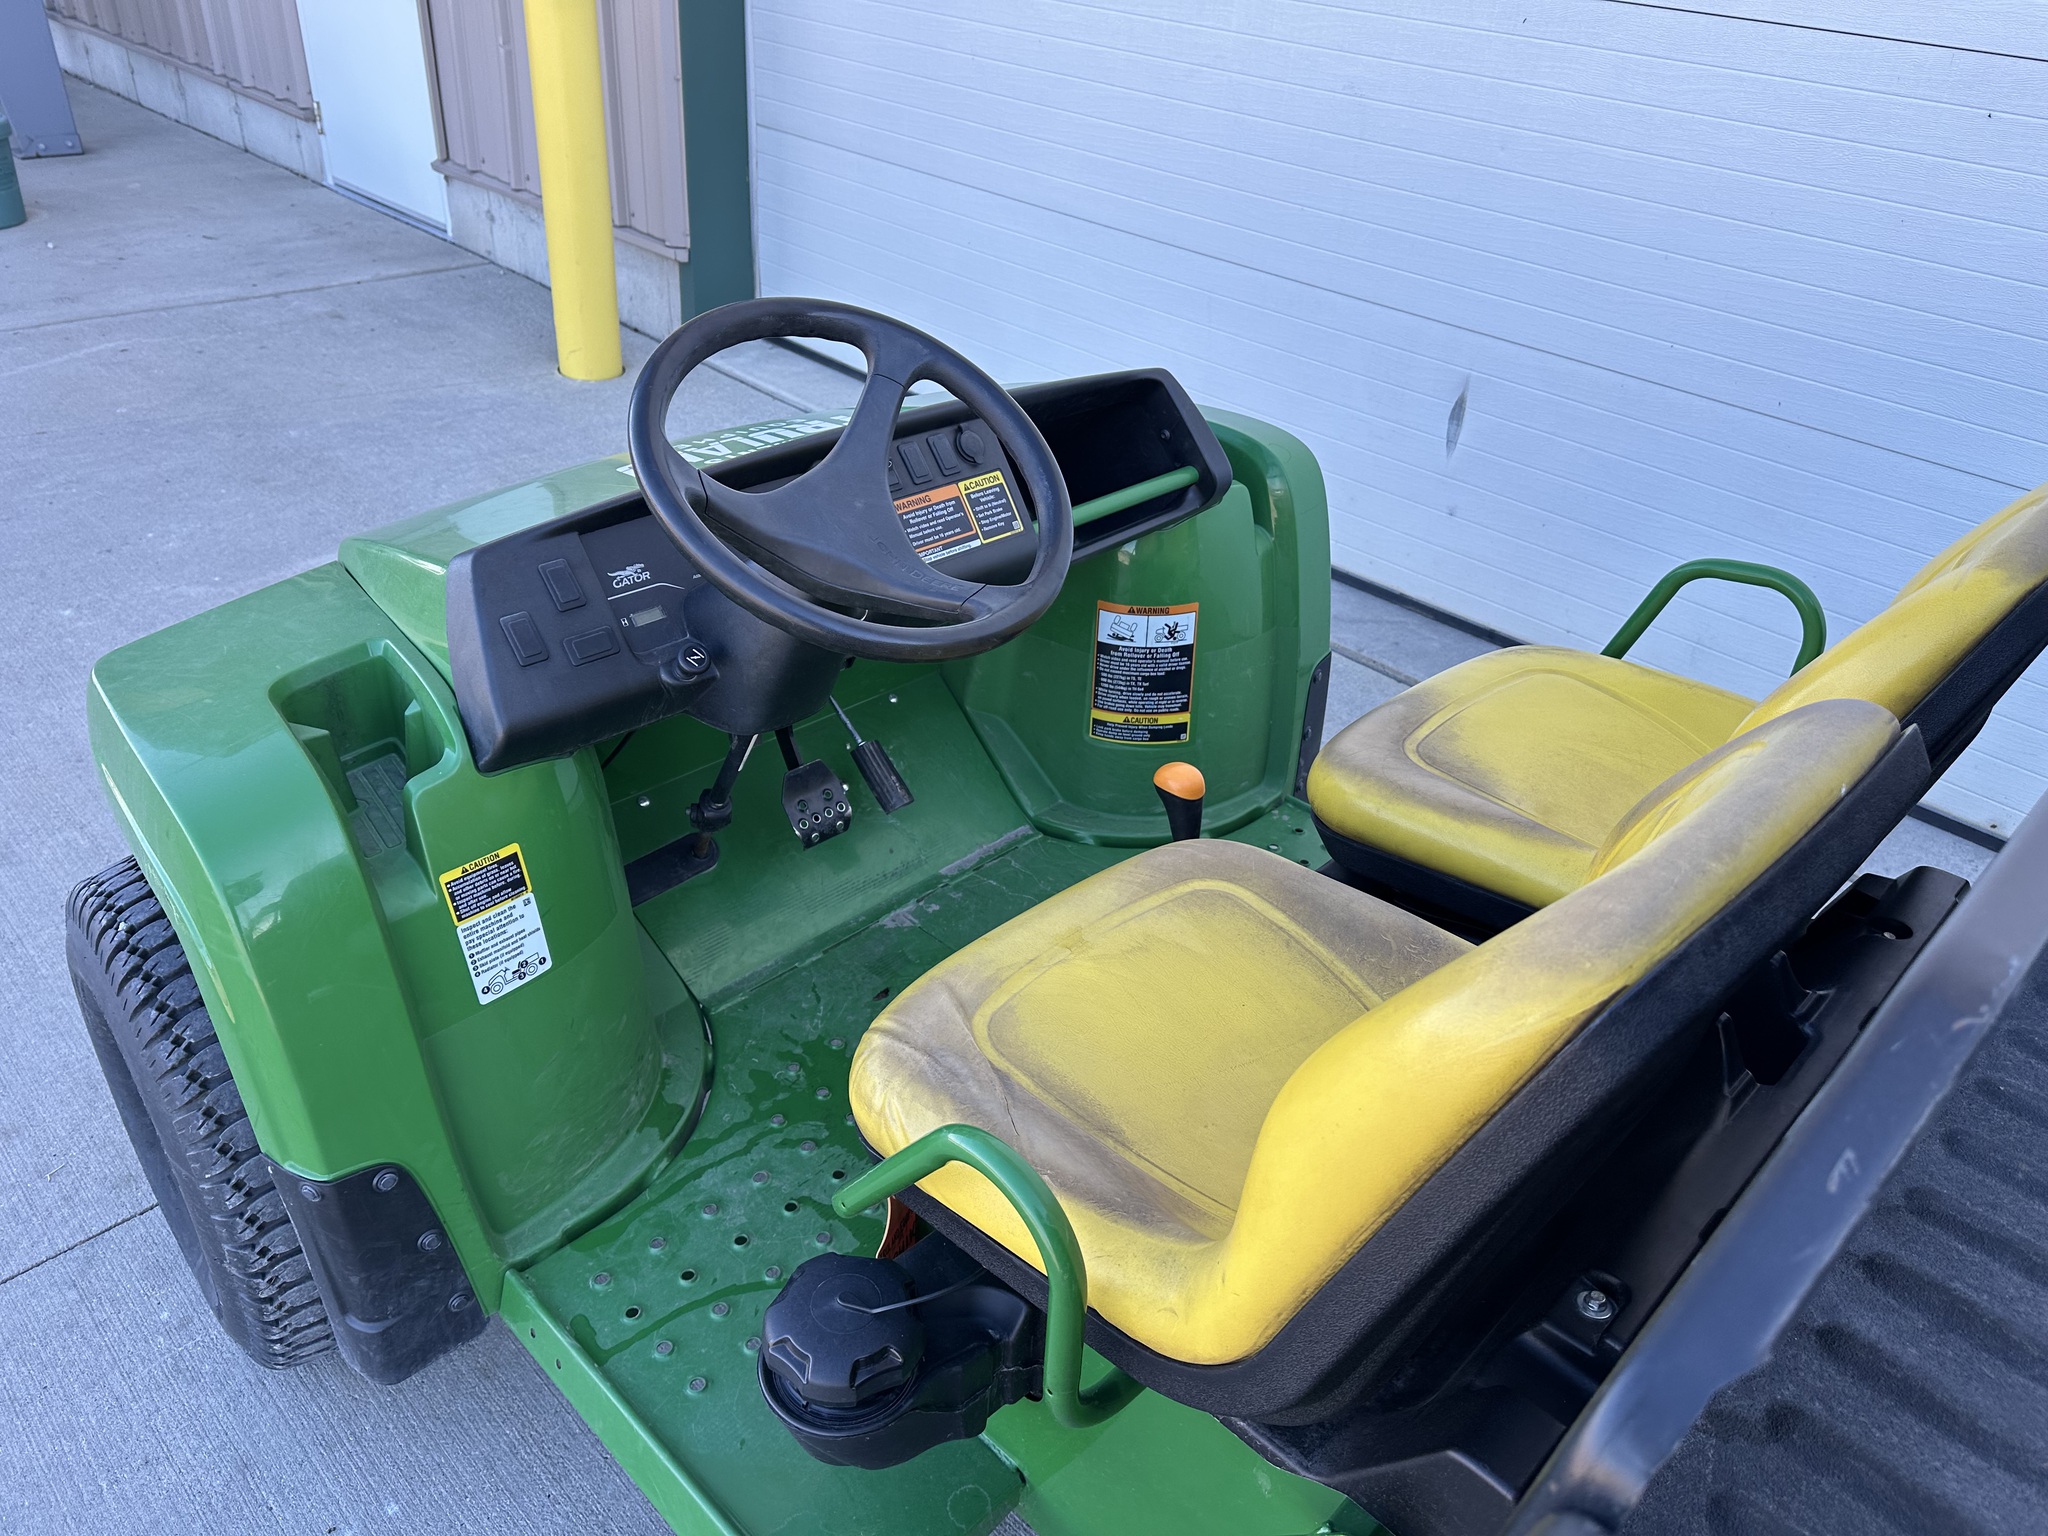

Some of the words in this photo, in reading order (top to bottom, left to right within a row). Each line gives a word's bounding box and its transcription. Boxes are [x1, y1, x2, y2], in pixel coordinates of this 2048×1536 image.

[969, 475, 999, 489] CAUTION
[894, 495, 931, 511] WARNING
[868, 535, 908, 572] JOHN
[910, 570, 964, 592] DEERE
[612, 571, 650, 588] GATOR
[469, 853, 499, 870] CAUTION
[464, 868, 486, 880] equipment
[461, 921, 480, 933] Inspect
[493, 909, 507, 918] clean
[464, 930, 479, 939] entire
[480, 919, 502, 931] machine
[476, 928, 495, 940] special
[497, 917, 518, 930] attention
[467, 942, 482, 951] these
[483, 930, 507, 943] locations:
[475, 947, 490, 955] Muffler
[499, 934, 514, 944] exhaust
